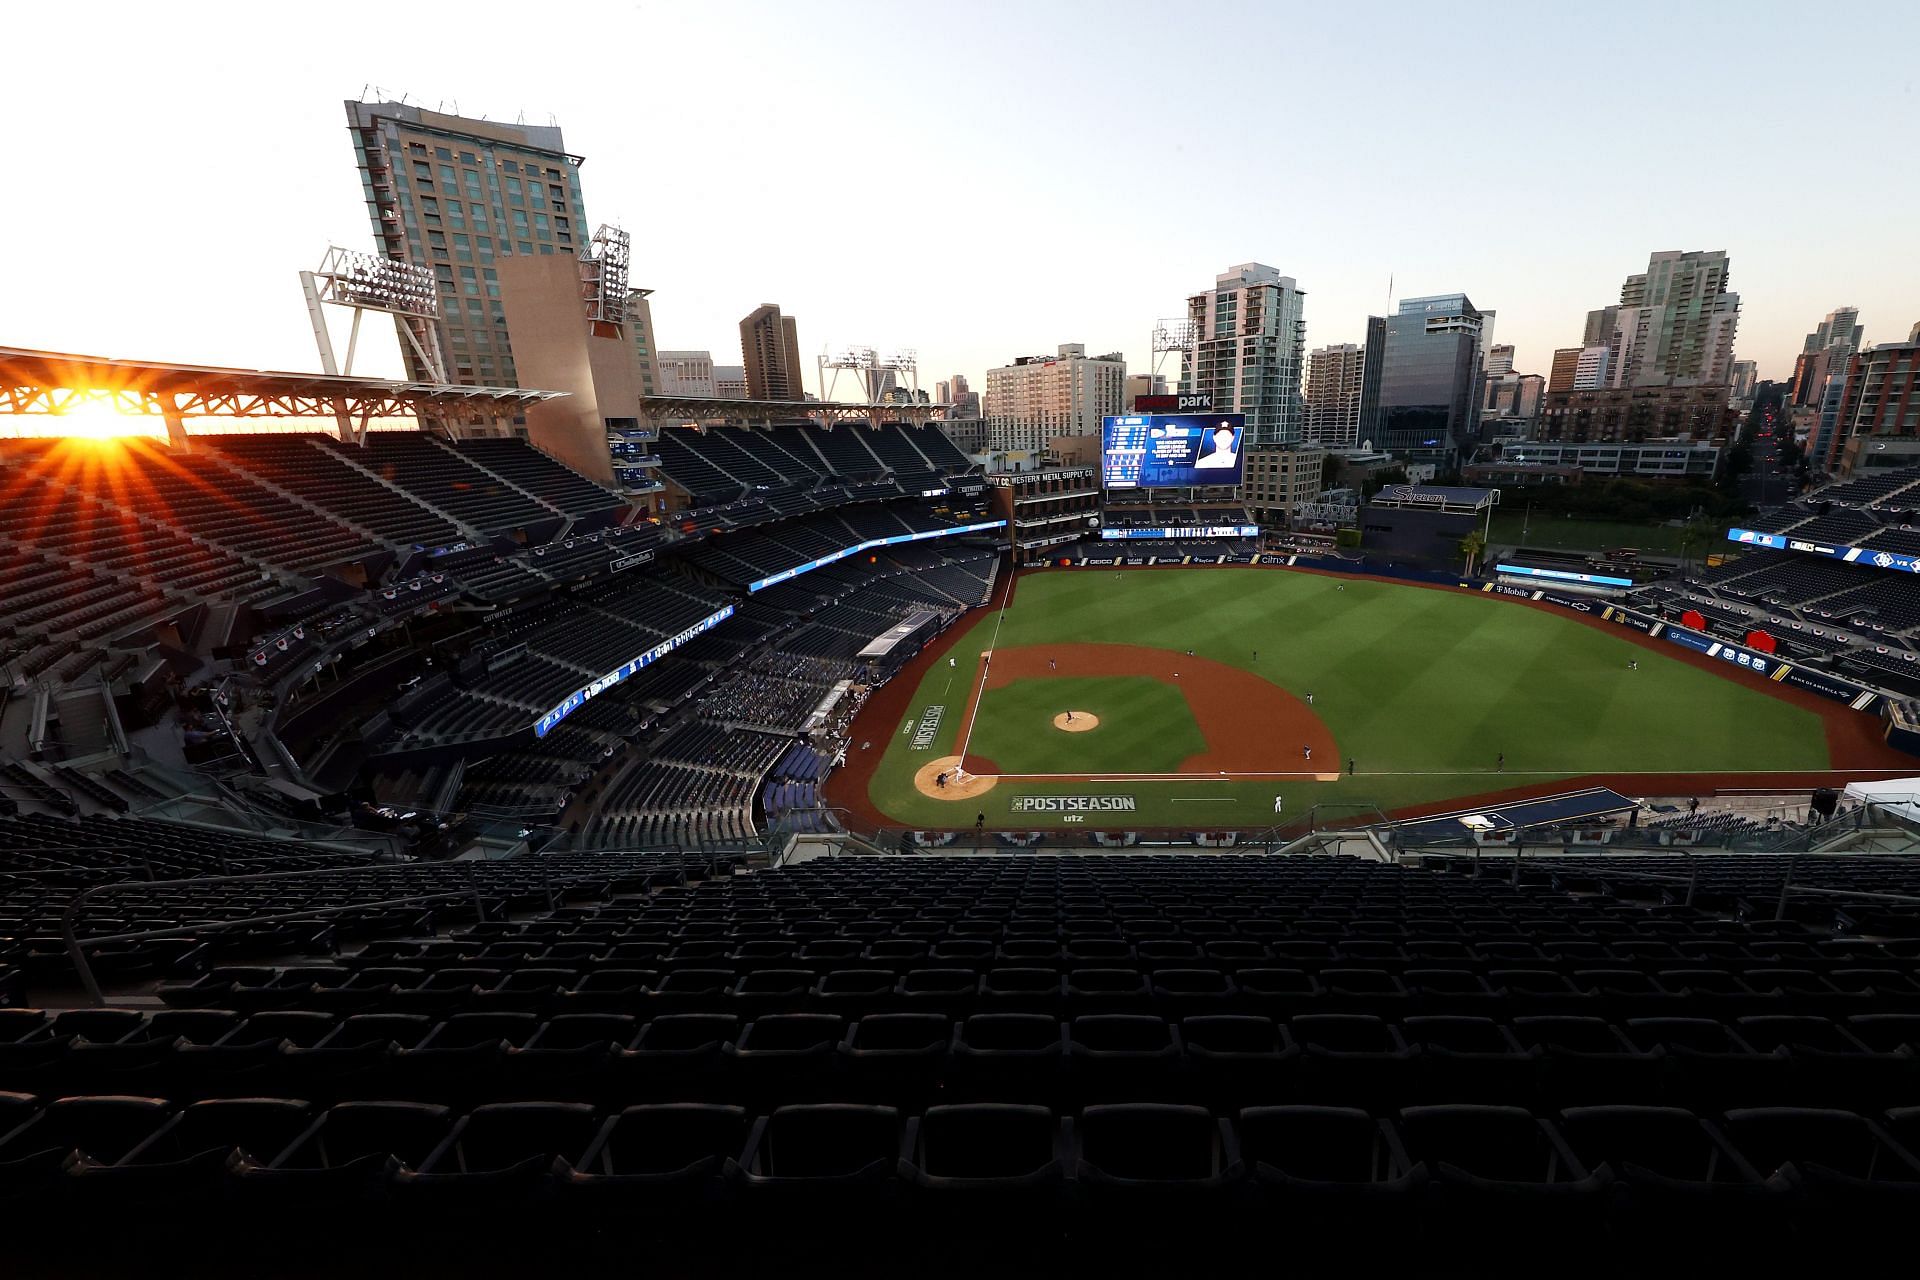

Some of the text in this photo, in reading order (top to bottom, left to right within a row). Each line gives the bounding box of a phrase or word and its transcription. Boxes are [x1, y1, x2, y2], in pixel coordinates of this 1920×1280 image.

[1178, 395, 1211, 409] park
[1012, 475, 1041, 485] WESTERN
[1042, 472, 1062, 481] METAL
[1062, 470, 1084, 480] SUPPLY
[1392, 485, 1448, 504] Sycuan
[1262, 556, 1285, 564] citrix
[1504, 587, 1529, 598] Mobile
[1546, 596, 1570, 606] CHEVROLET
[483, 607, 513, 623] CUTWATER
[1624, 616, 1649, 630] BETMGM
[368, 628, 376, 638] 51
[1790, 675, 1805, 684] BANK
[1813, 684, 1838, 695] AMERICA
[912, 706, 944, 744] POSTSEASON
[1023, 797, 1135, 810] POSTSEASON
[1063, 814, 1084, 822] utz
